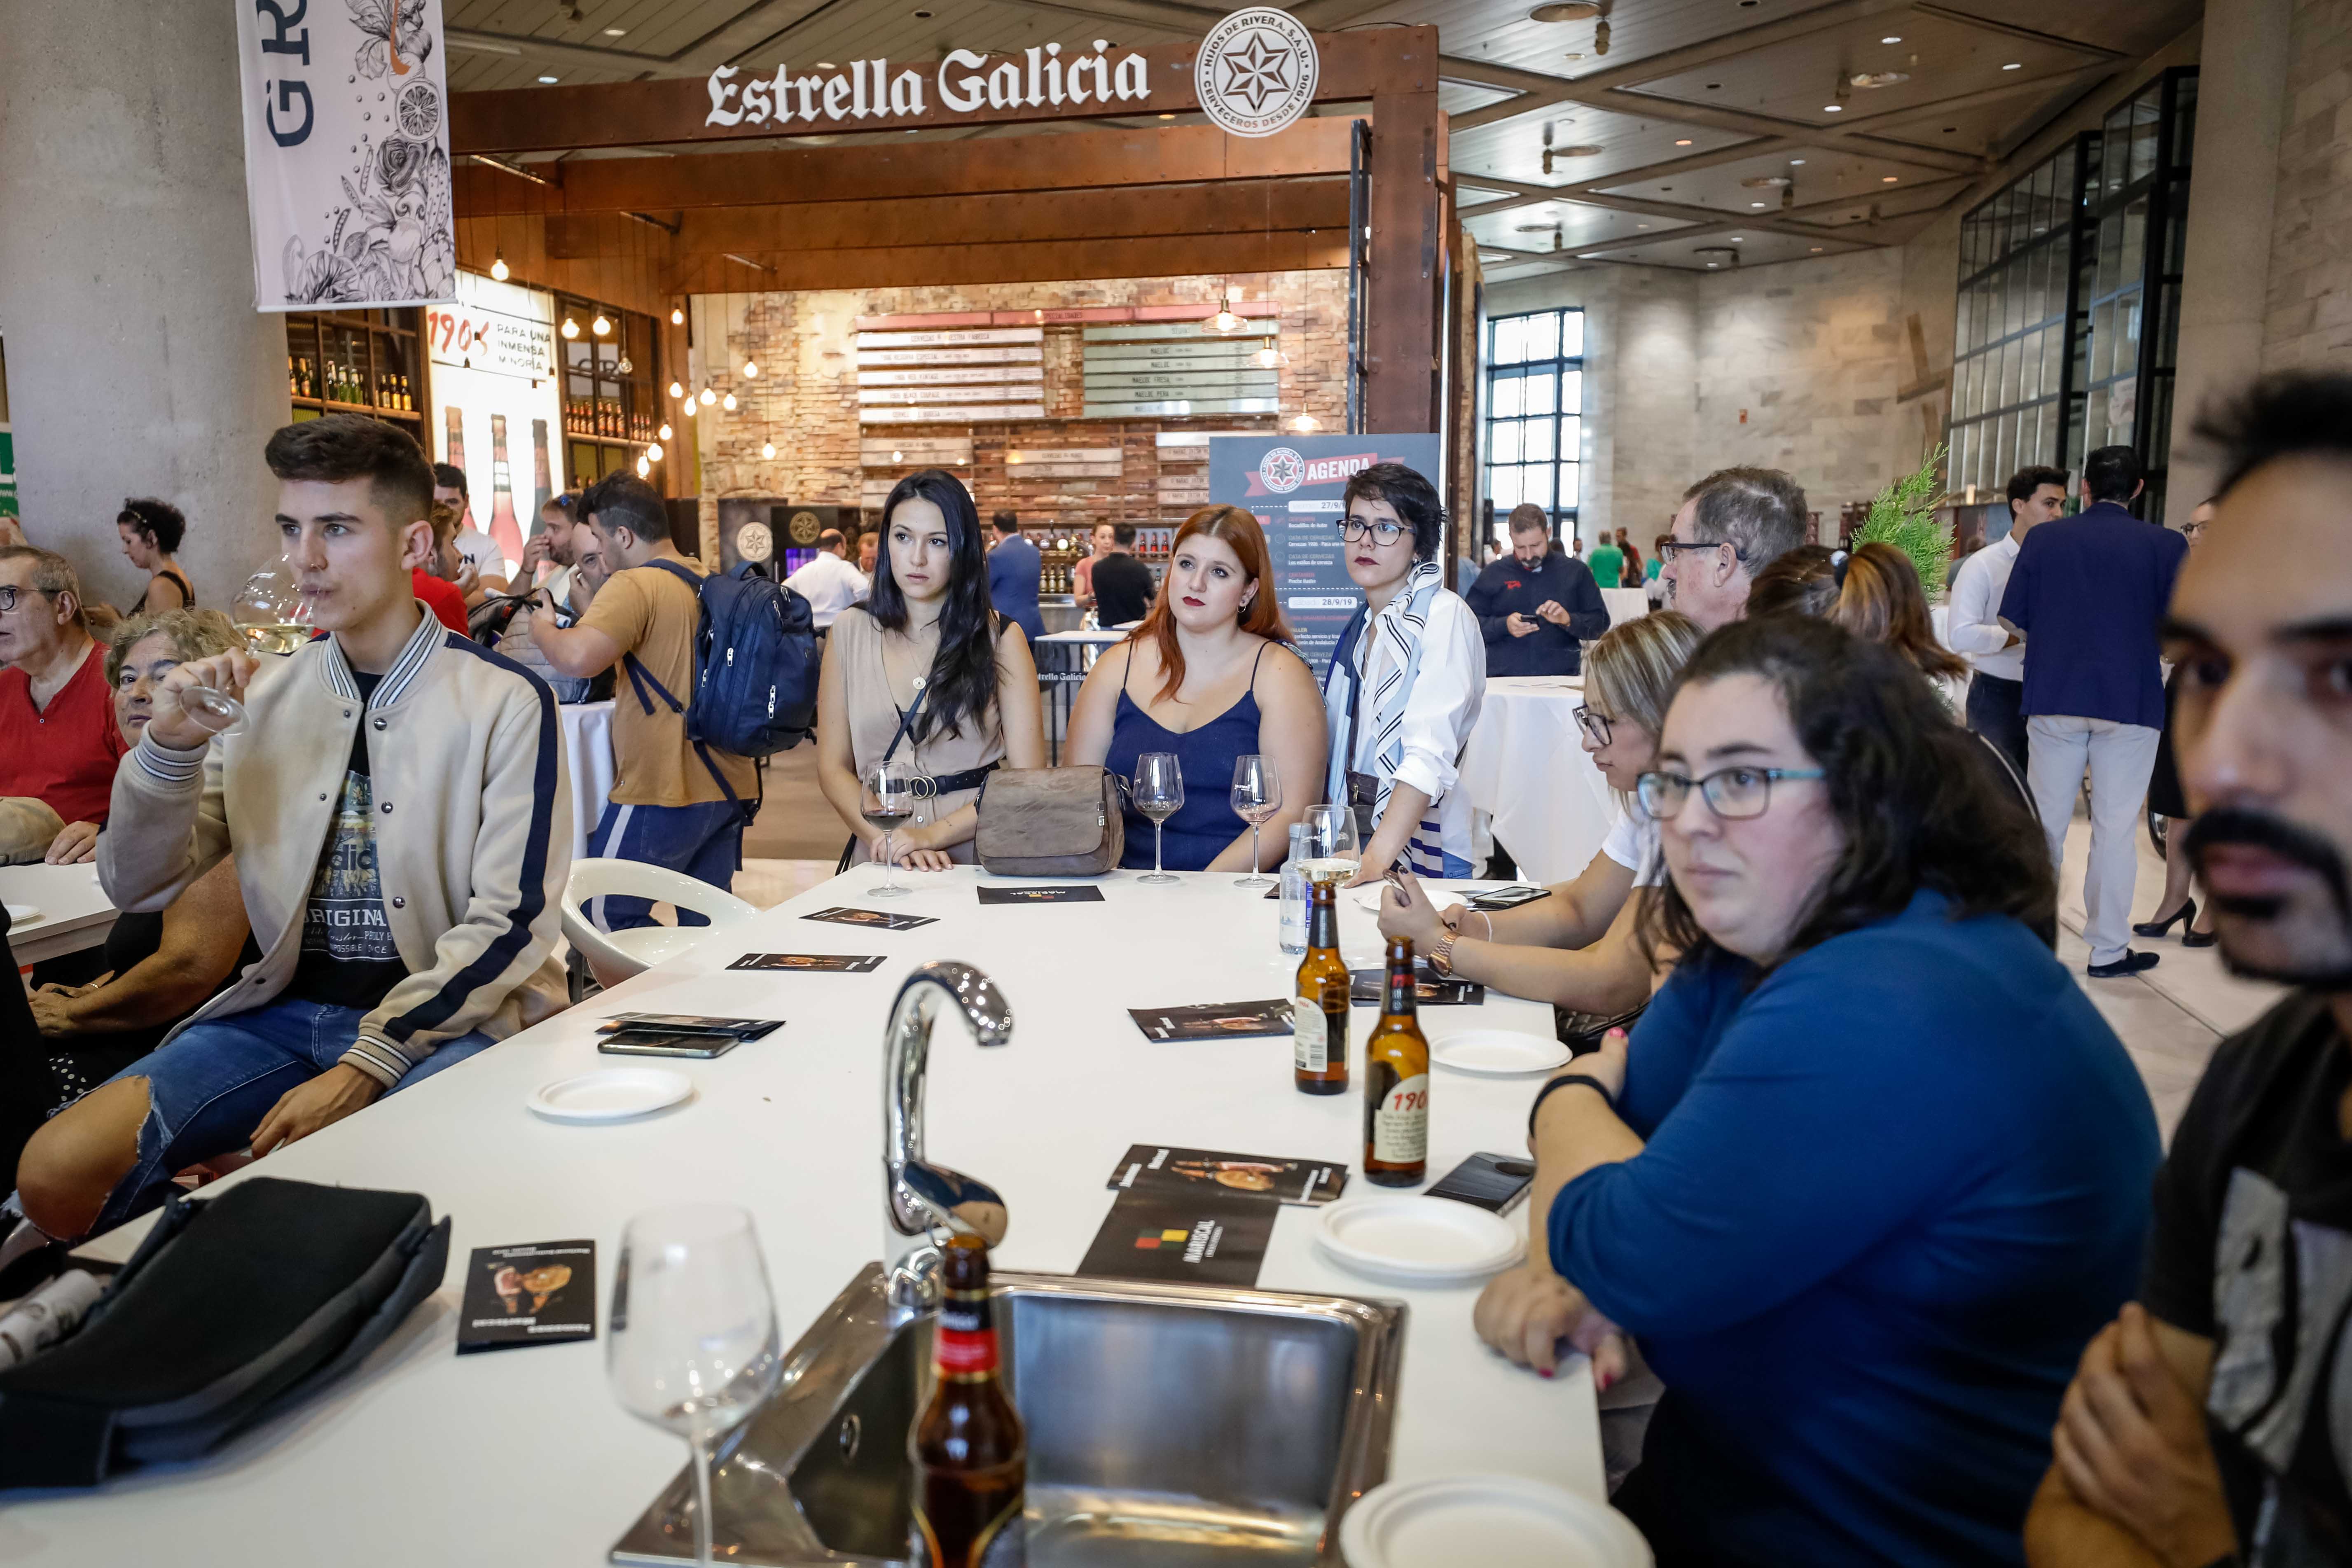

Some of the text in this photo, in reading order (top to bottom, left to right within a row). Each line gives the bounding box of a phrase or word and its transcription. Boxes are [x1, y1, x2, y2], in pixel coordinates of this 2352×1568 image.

[1204, 35, 1225, 67] HIJOS
[1225, 22, 1239, 35] DE
[1287, 28, 1309, 63] S.A.U.
[705, 39, 1152, 127] Estrella Galicia
[1204, 75, 1309, 128] CERVECEROS DESDE 1906
[497, 324, 551, 342] PARA UNA
[498, 340, 545, 356] INMENSA
[1307, 458, 1370, 480] AGENDA
